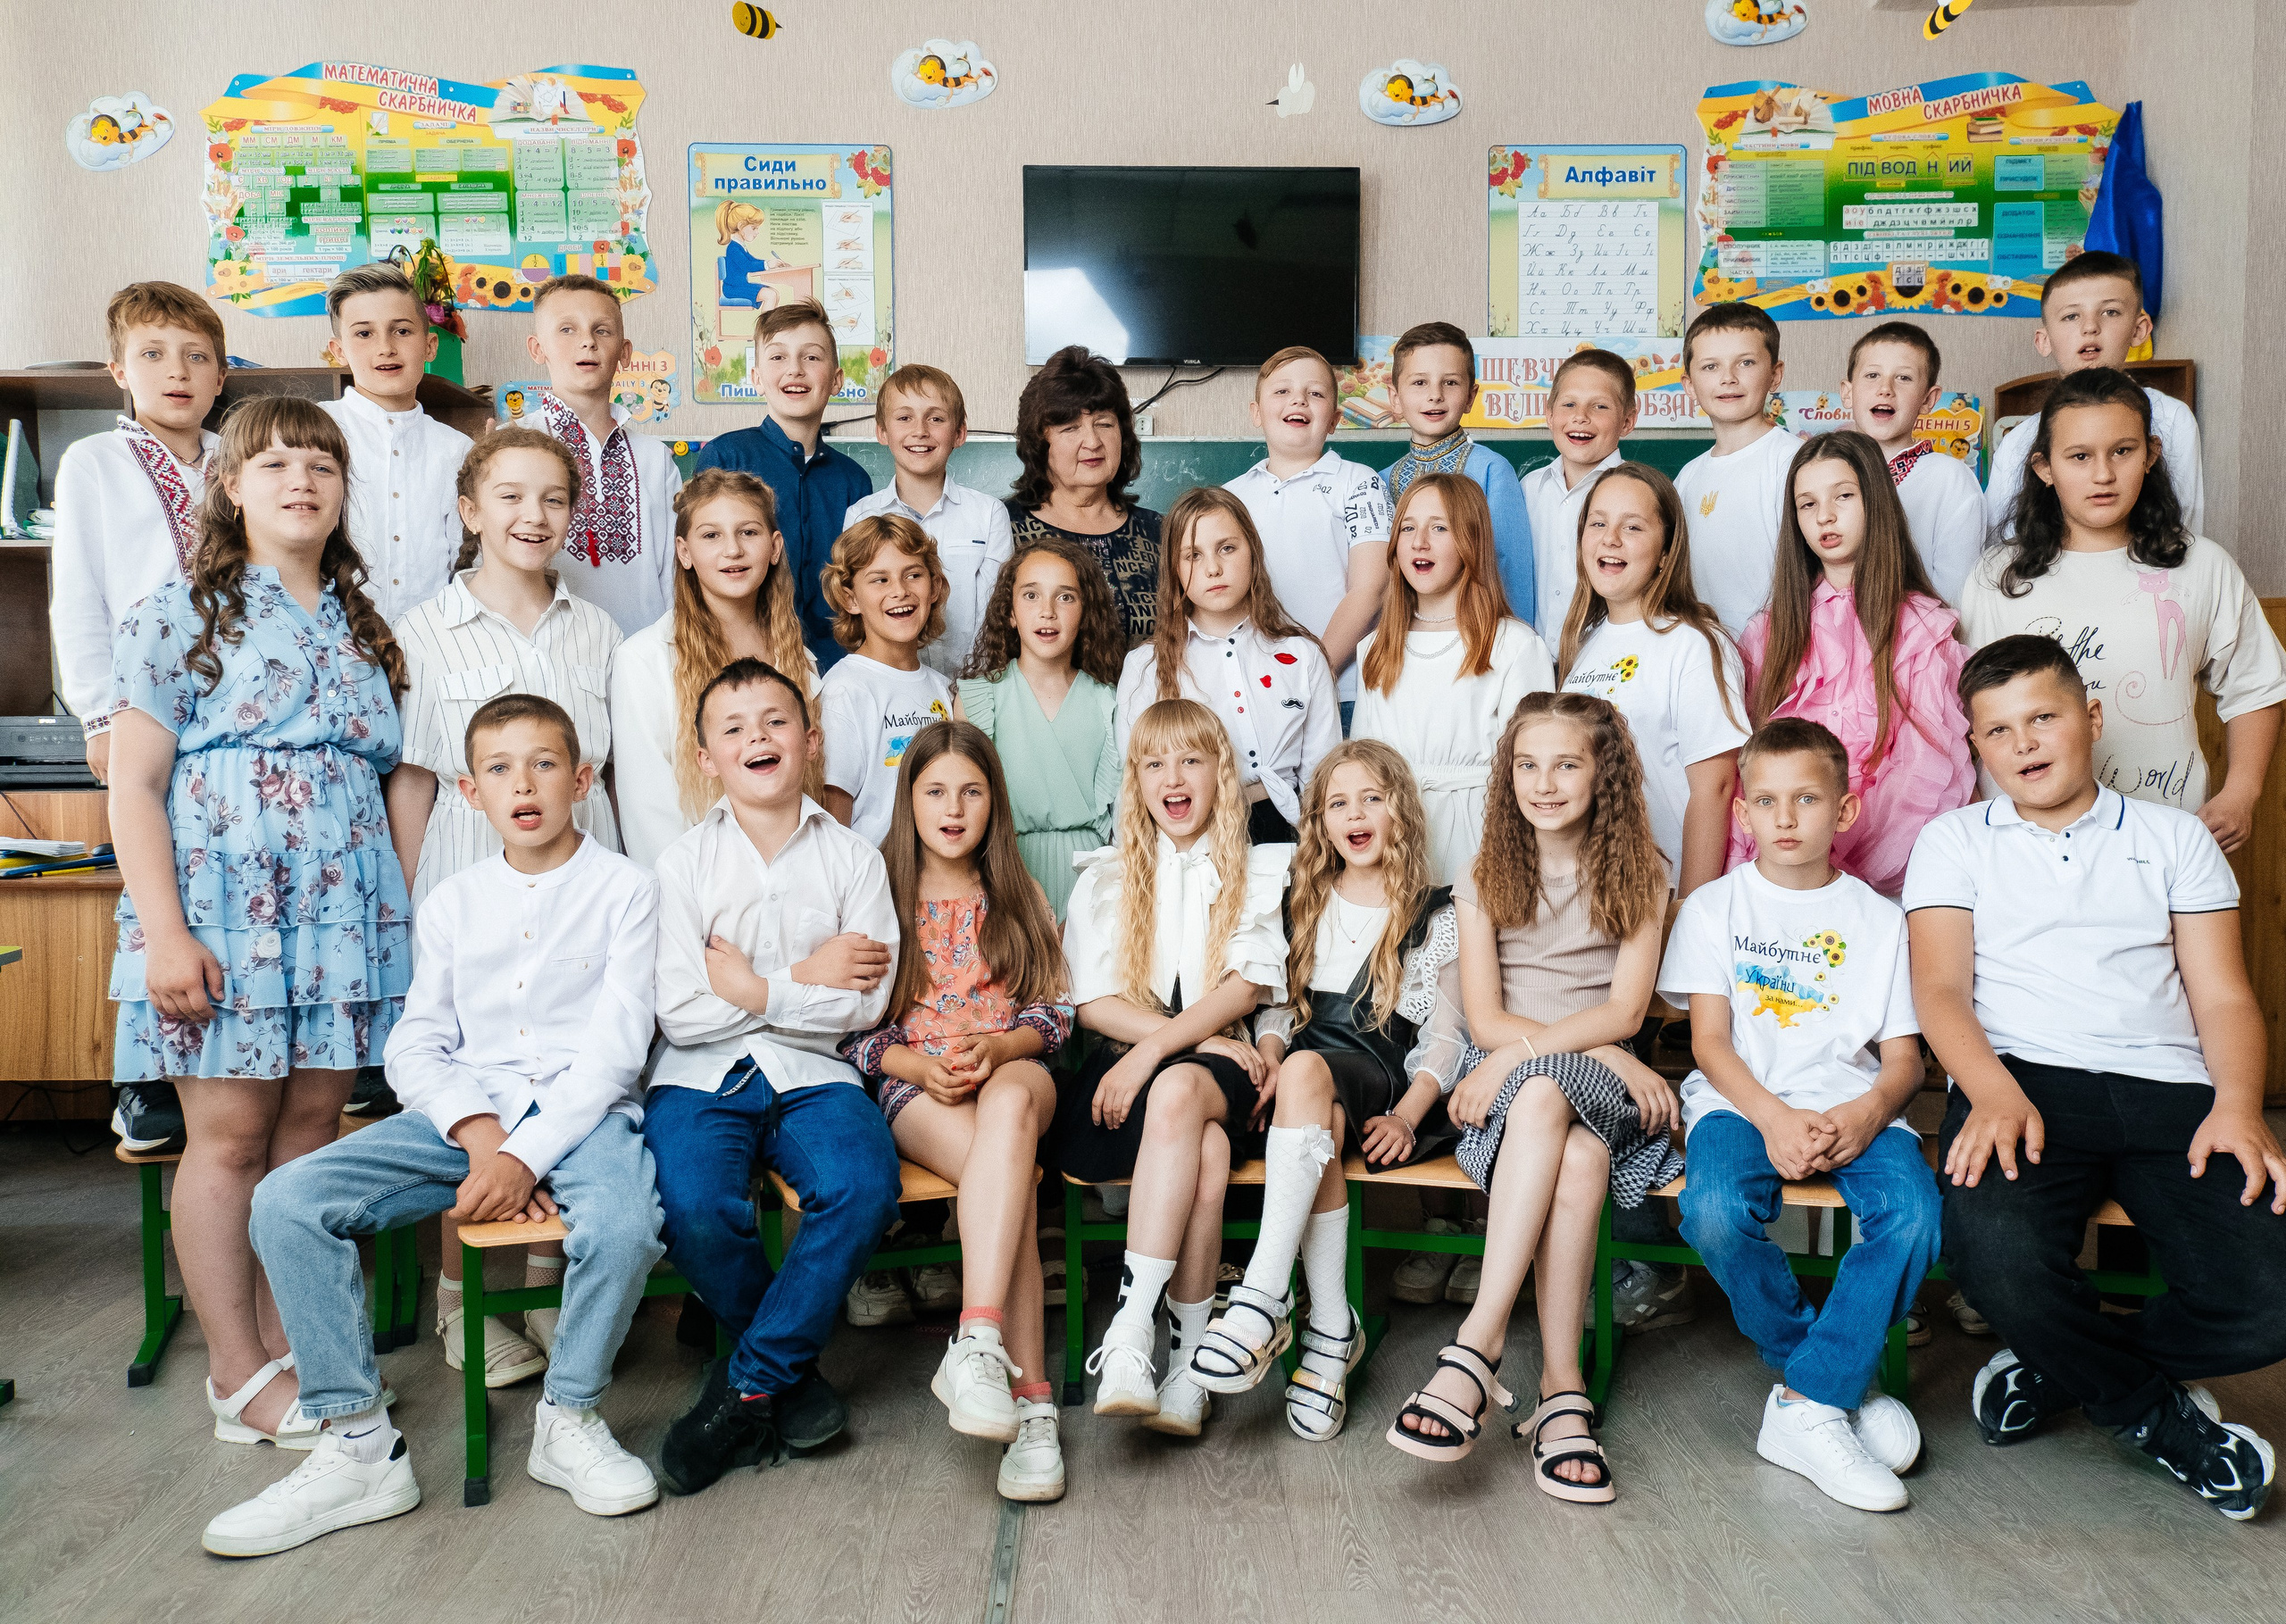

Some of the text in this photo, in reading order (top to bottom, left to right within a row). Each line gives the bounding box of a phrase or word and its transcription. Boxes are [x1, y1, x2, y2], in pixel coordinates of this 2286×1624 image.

[324, 64, 438, 96] МАТЕМАТИЧНА
[379, 91, 476, 121] СКАРБНИЧКА
[1869, 88, 1923, 114] МОВНА
[1923, 84, 2022, 121] СКАРБНИЧКА
[266, 136, 278, 144] СМ
[744, 155, 797, 175] Сиди
[1564, 165, 1656, 187] Алфавіт
[1848, 156, 1972, 177] ПІД ВОД Н ИЙ
[238, 191, 262, 199] ДОБА
[713, 178, 827, 193] правильно
[303, 267, 332, 275] гектари
[660, 360, 668, 371] 3
[722, 384, 763, 397] Пиш
[1485, 393, 1548, 421] ВЕЛИ
[1798, 407, 1971, 431] Словн ДЕННІ 5
[1734, 936, 1821, 964] Майбутнє
[1745, 969, 1795, 993] України
